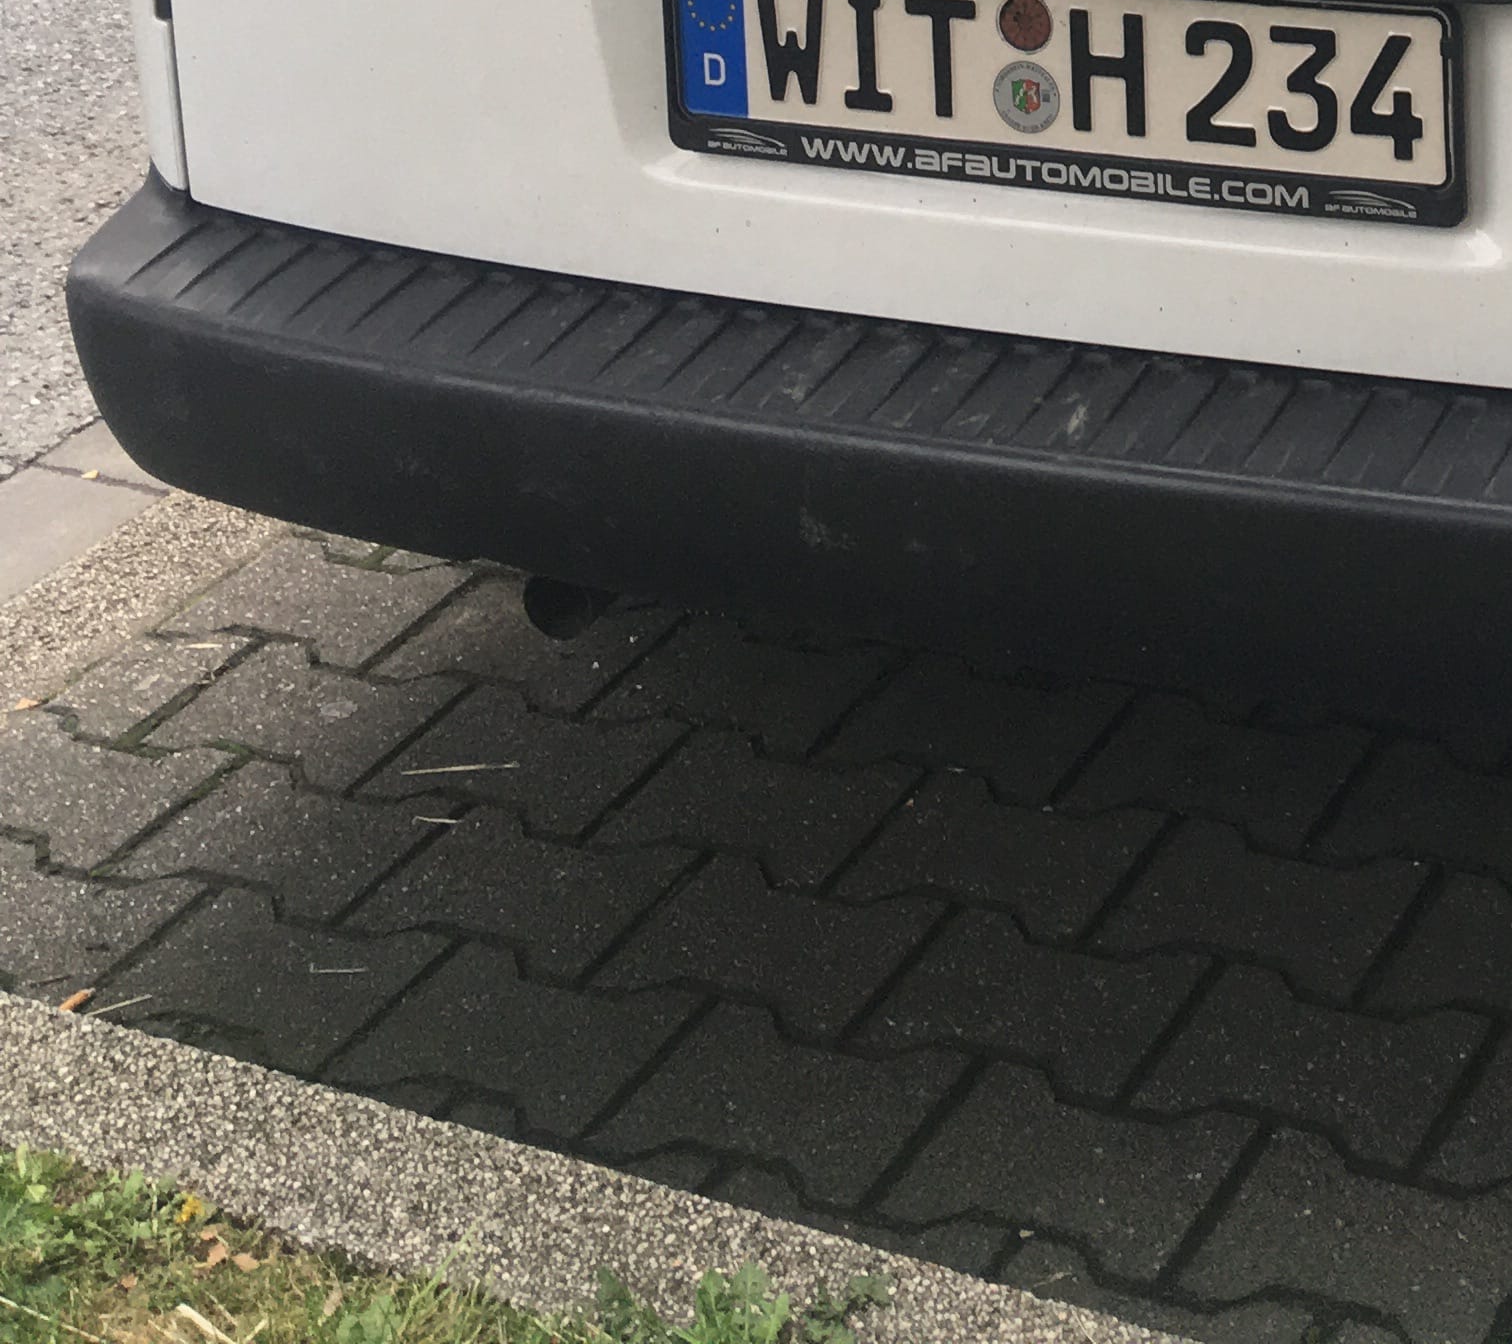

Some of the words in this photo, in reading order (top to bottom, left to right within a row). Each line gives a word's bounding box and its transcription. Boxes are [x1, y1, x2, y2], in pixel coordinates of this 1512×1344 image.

[703, 52, 726, 86] D
[1069, 9, 1146, 139] H
[1184, 20, 1424, 161] 234
